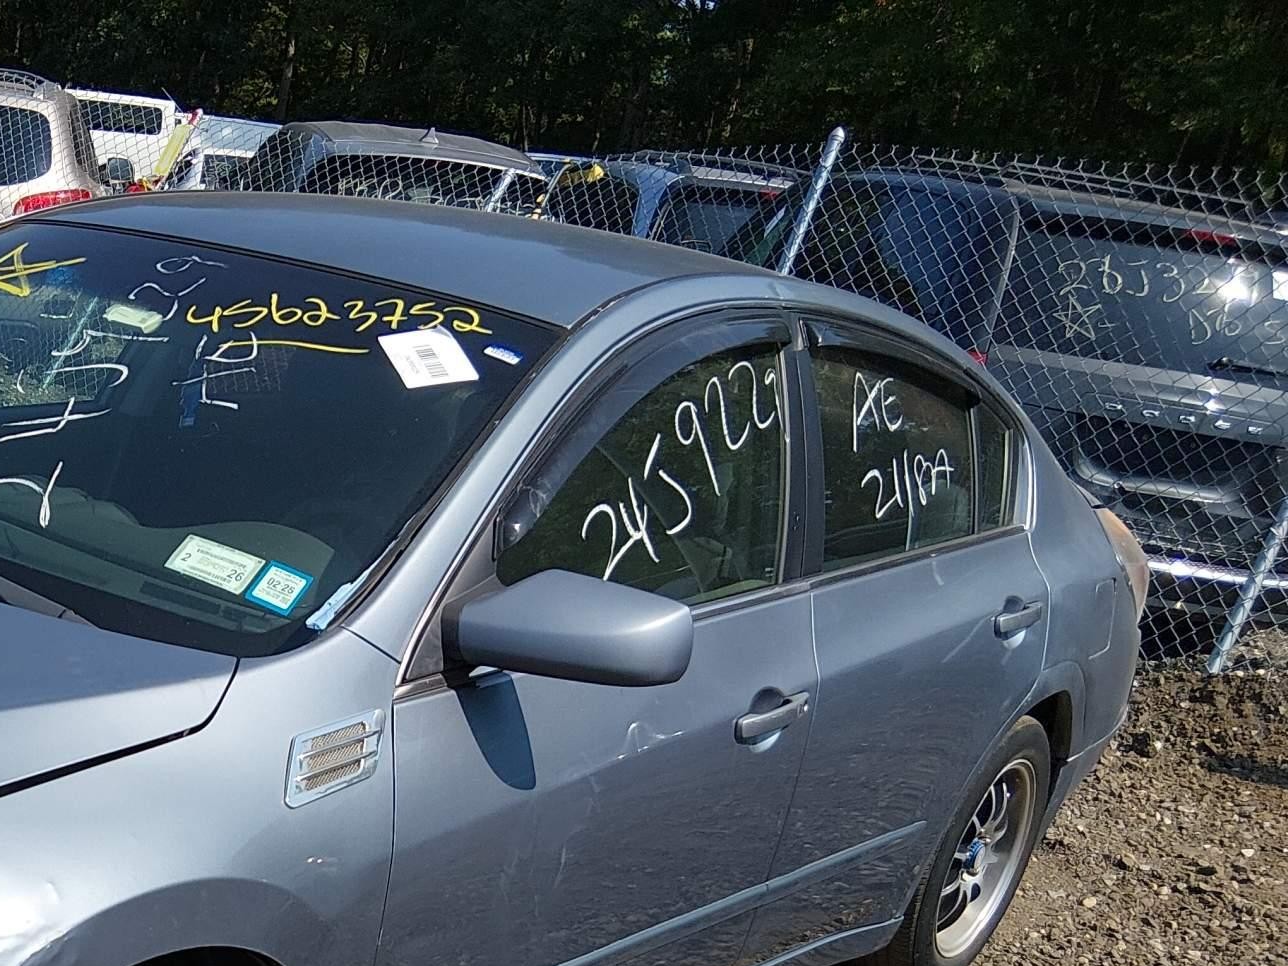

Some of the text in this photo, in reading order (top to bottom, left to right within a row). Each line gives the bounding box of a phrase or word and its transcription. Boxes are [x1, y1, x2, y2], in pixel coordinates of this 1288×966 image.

[186, 292, 493, 335] 45623752
[852, 371, 904, 454] AE
[180, 552, 192, 562] 2
[226, 568, 245, 582] 26
